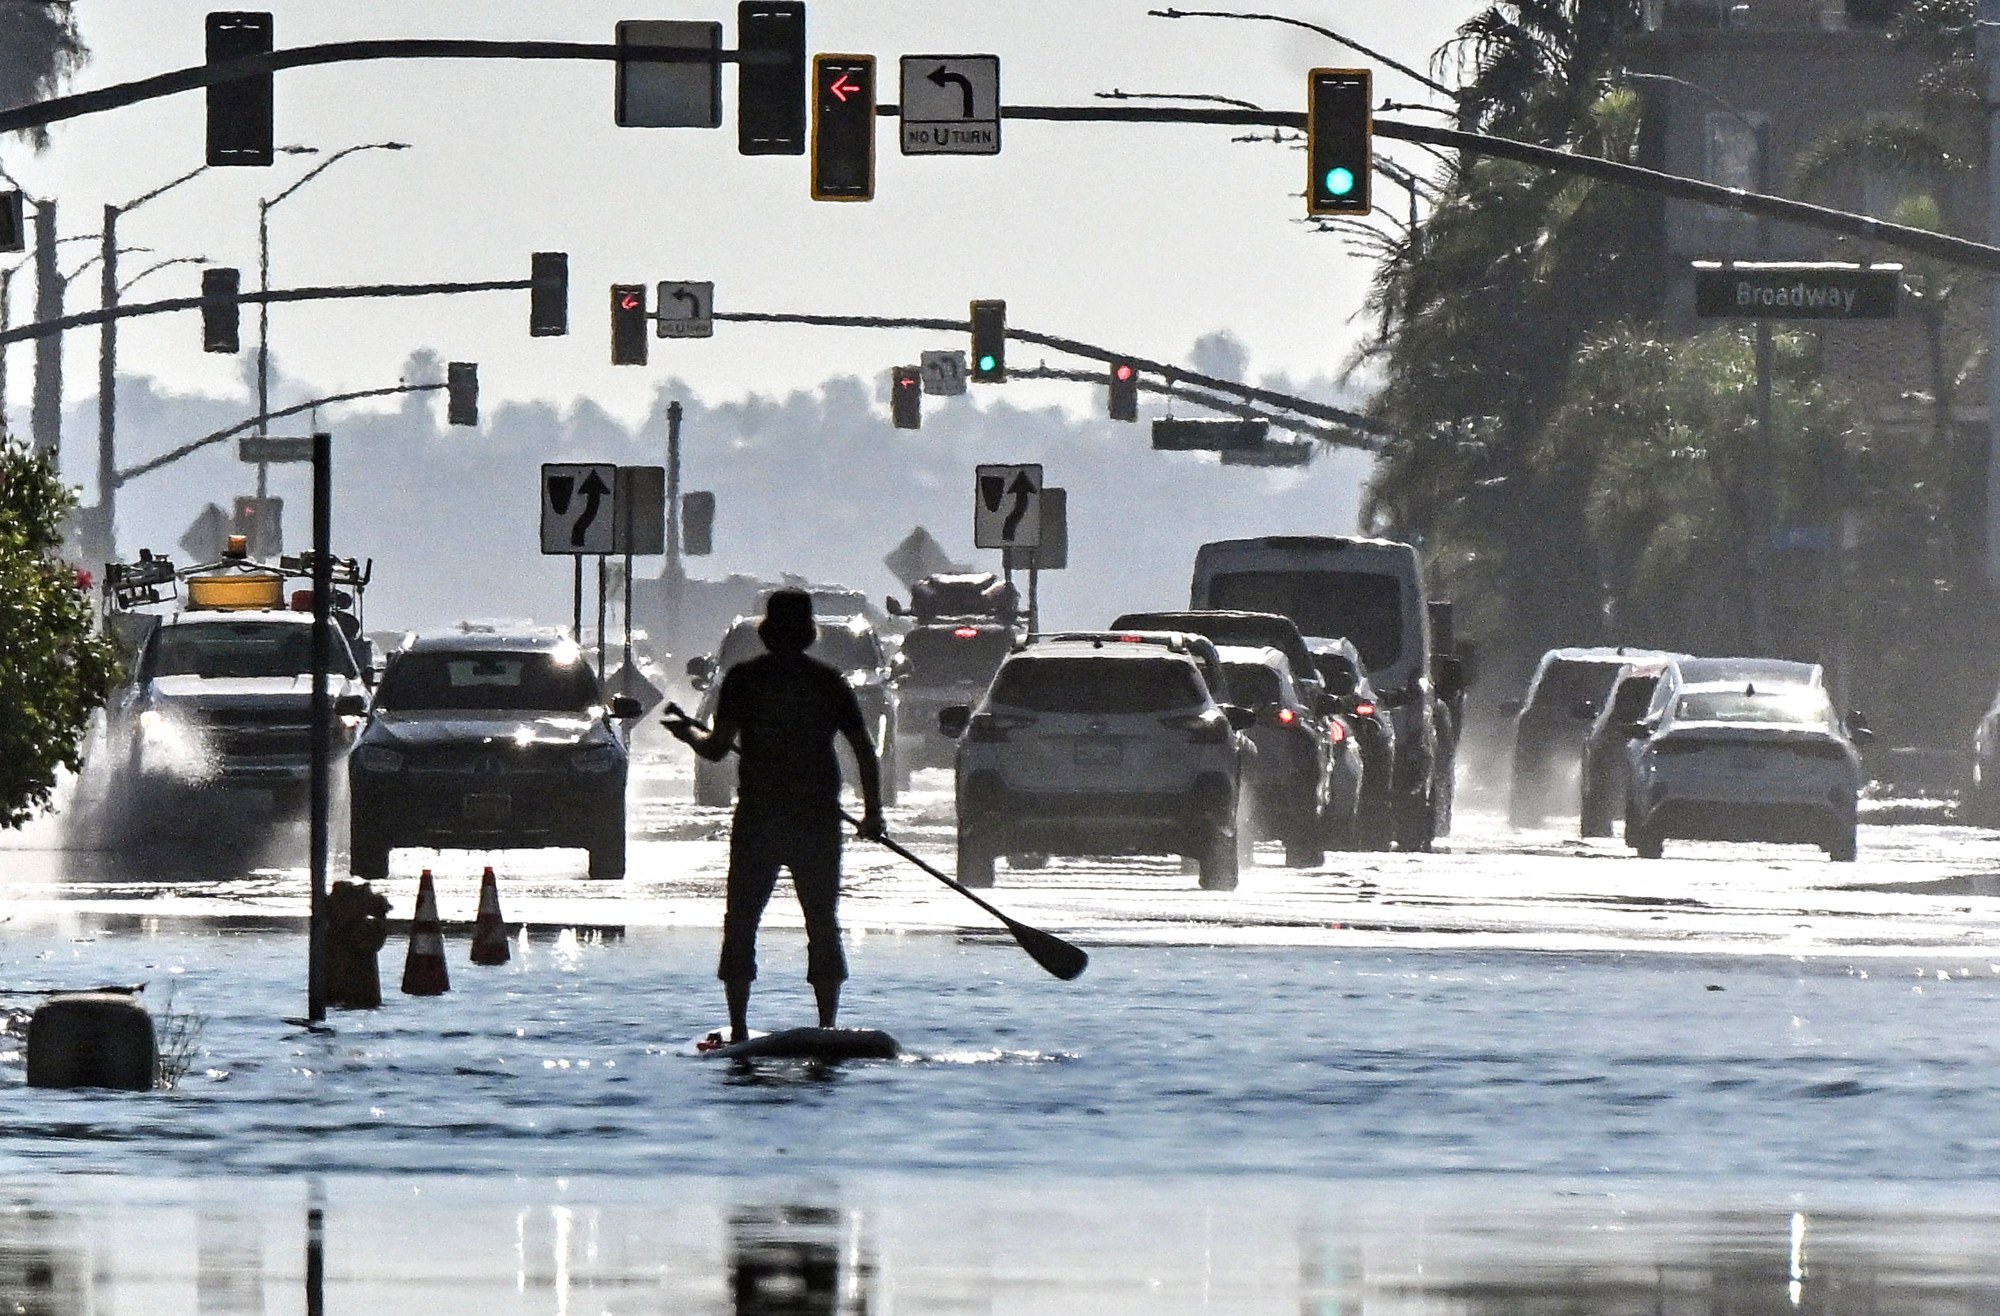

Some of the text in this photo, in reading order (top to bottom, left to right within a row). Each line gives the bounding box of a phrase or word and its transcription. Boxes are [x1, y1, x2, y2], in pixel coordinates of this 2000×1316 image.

[908, 128, 991, 146] NO U TURN
[1736, 281, 1856, 313] Broadway
